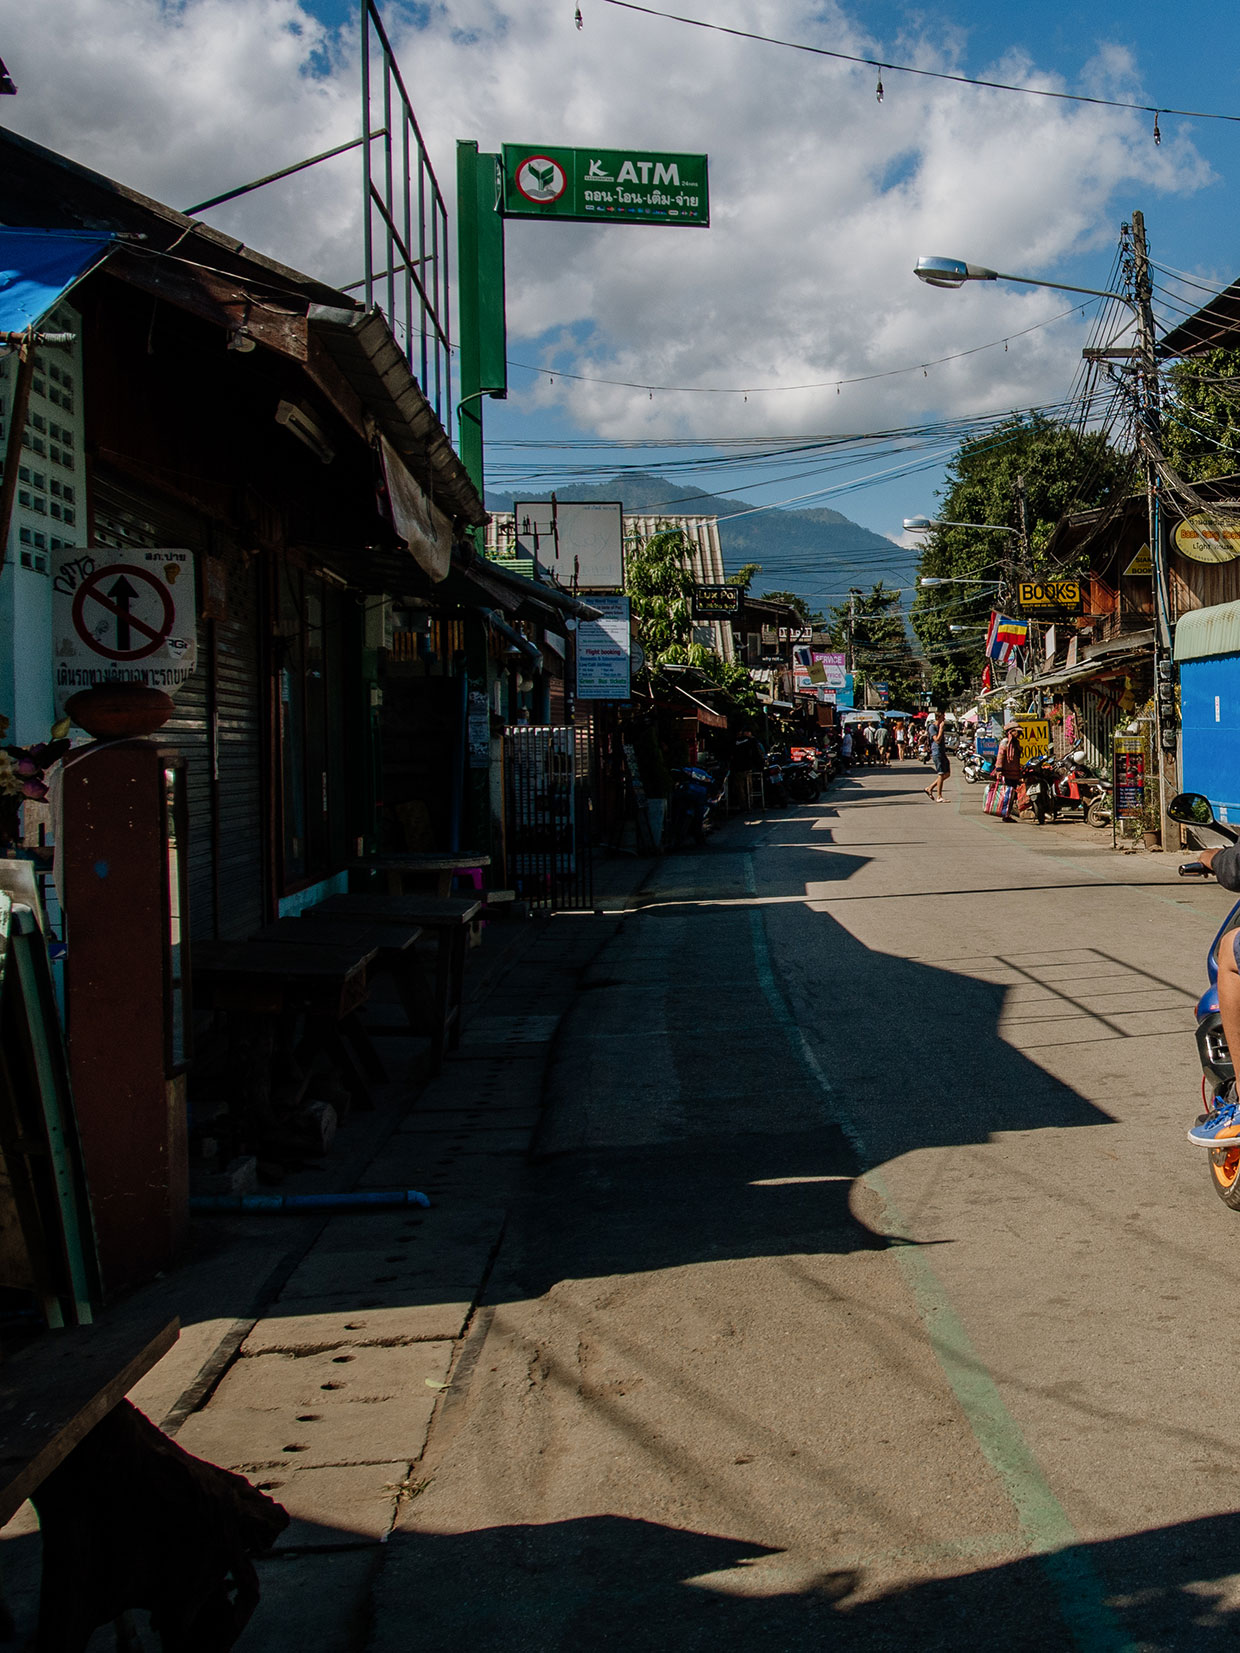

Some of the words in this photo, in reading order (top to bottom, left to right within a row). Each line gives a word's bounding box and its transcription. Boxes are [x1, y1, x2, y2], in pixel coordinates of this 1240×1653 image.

[616, 161, 680, 186] ATM
[584, 187, 699, 206] ถอน-โอน-เติม-จ่าย
[1022, 584, 1076, 600] BOOKS
[600, 648, 621, 656] booking
[815, 656, 842, 664] SERVICE
